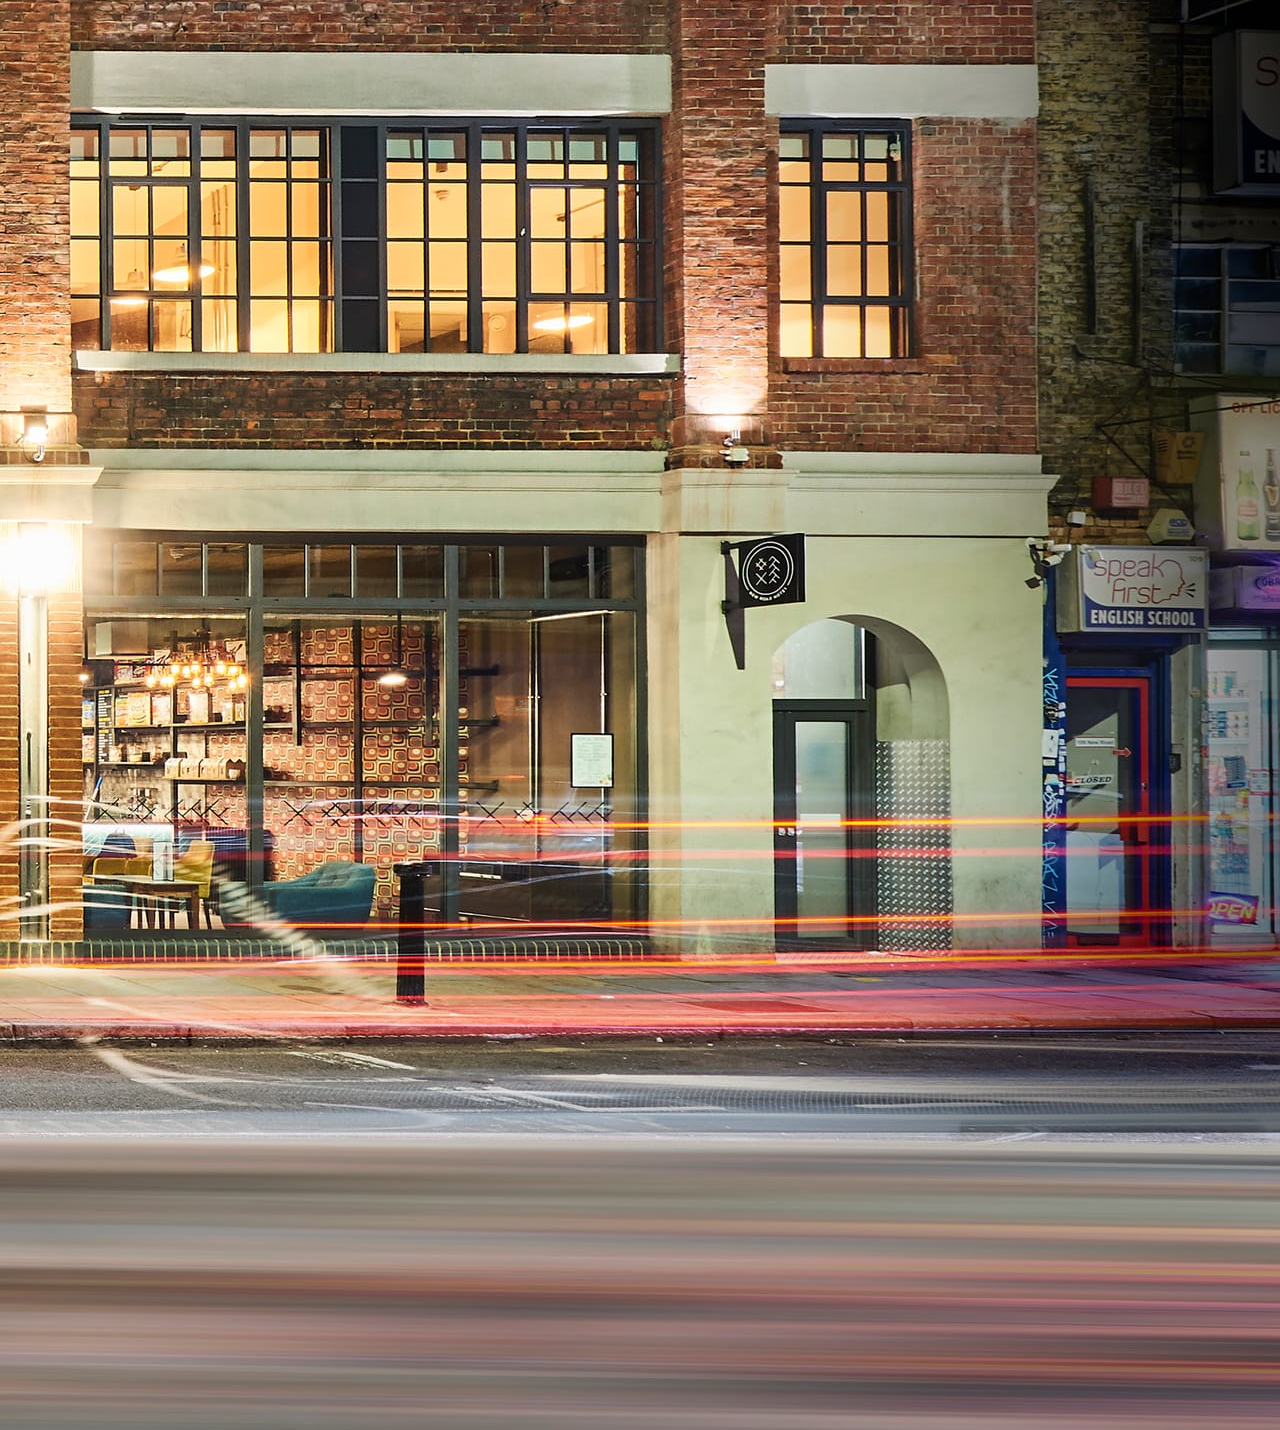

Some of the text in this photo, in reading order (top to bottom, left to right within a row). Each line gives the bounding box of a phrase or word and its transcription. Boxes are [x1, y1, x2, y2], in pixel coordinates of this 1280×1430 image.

[1093, 554, 1165, 585] speak
[1111, 577, 1163, 605] first
[1090, 609, 1196, 627] ENGLISH SCHOOL
[1074, 776, 1112, 784] CLOSED
